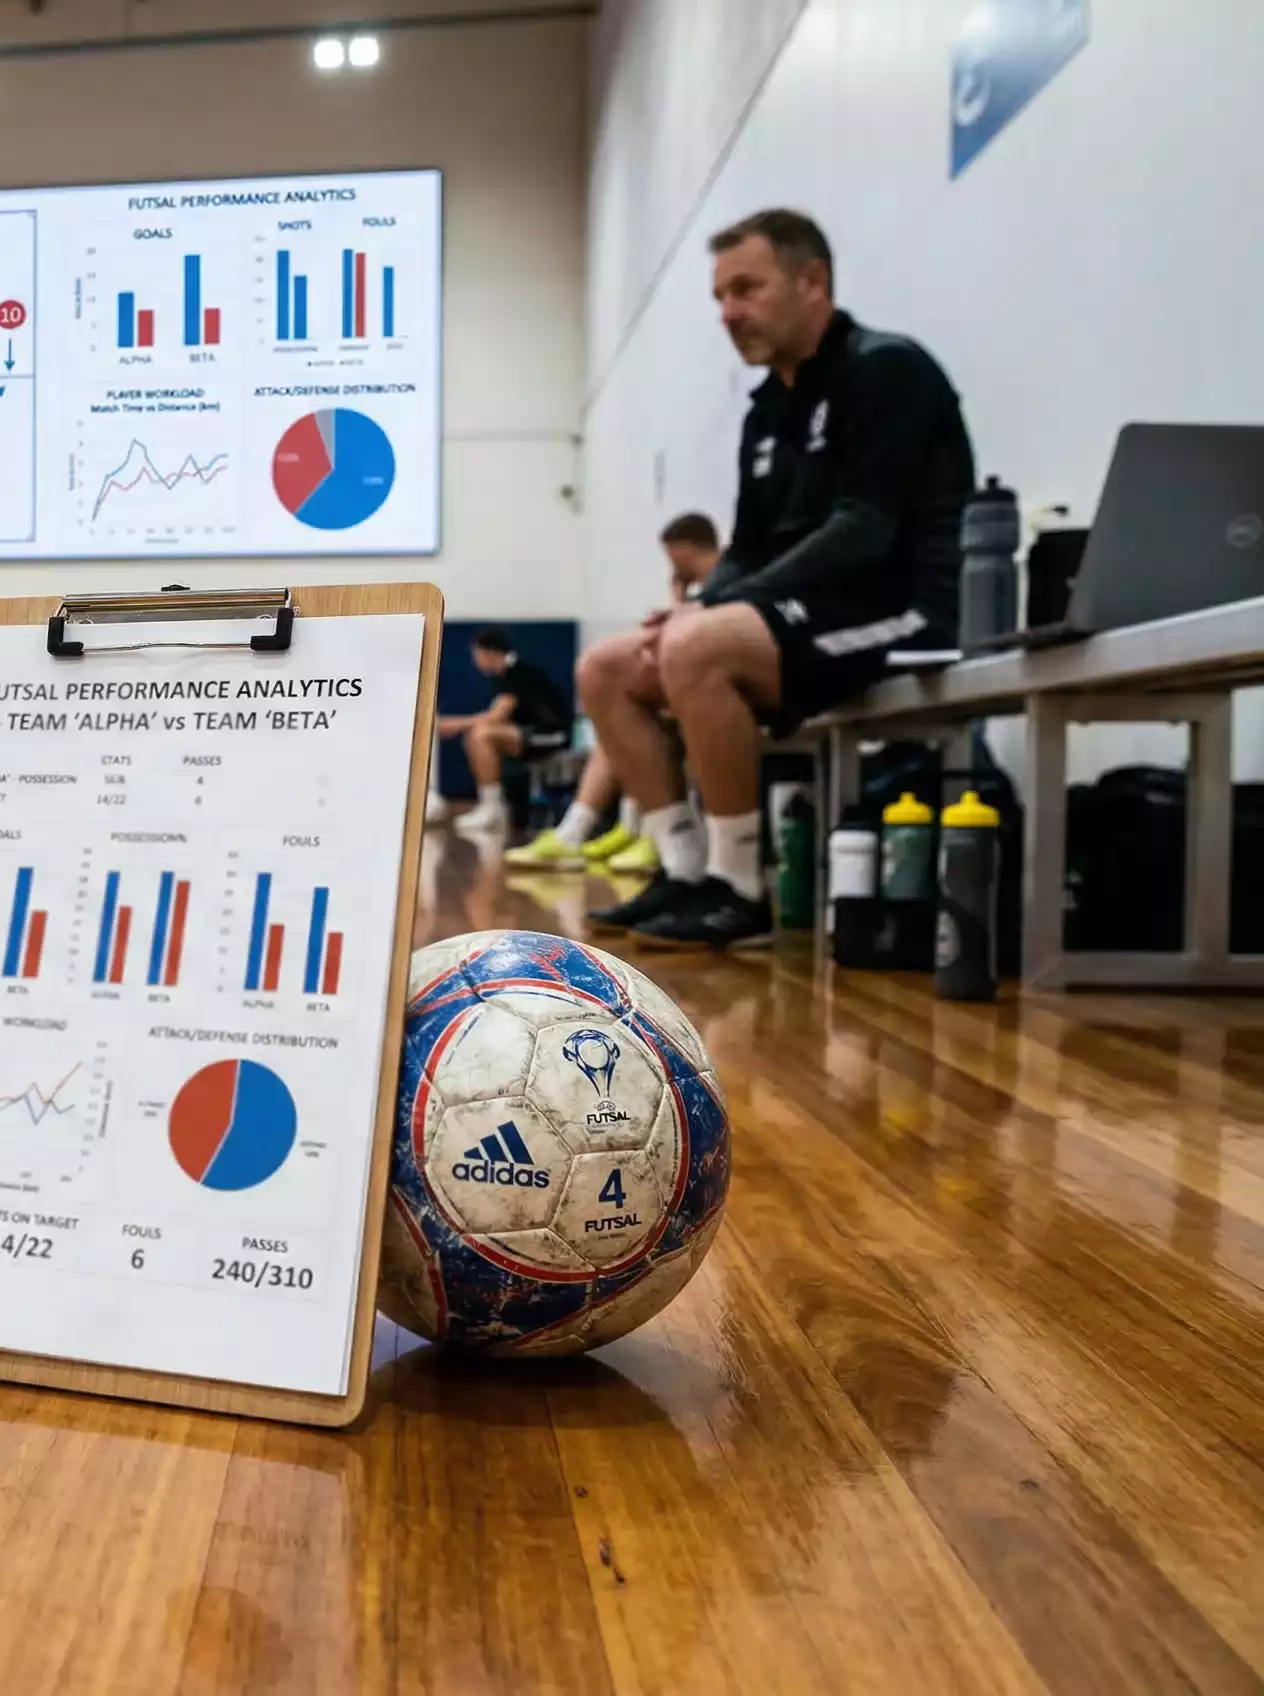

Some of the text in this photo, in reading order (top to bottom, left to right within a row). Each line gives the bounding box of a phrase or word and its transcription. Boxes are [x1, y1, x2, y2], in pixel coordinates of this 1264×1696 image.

[128, 188, 356, 210] FUTSAL PERFORMANCE ANALYTICS
[133, 227, 173, 240] GOALS
[0, 307, 21, 323] 10
[106, 388, 205, 400] PLAYER WORKLOAD
[254, 384, 416, 397] ATTACK/DEFENSE DISTRIBUTION
[65, 681, 230, 700] PERFORMANCE
[236, 678, 363, 698] ANALYTICS
[7, 713, 67, 730] TEAM
[74, 711, 157, 730] ‘ALPHA’
[163, 716, 186, 730] vs
[194, 711, 257, 730] TEAM
[265, 710, 337, 730] ‘BETA’
[183, 755, 222, 767] PASSES
[18, 774, 77, 784] POSSESSION
[282, 835, 320, 847] FOULS
[3, 1016, 68, 1031] WORKLOAD
[148, 1026, 339, 1049] ATTACK/DEFENSE DISTRIBUTION
[587, 1111, 631, 1125] FUTSAL
[452, 1159, 550, 1189] adidas
[598, 1168, 627, 1209] 4
[11, 1211, 30, 1224] ON
[34, 1214, 79, 1230] TARGET
[585, 1213, 642, 1233] FUTSAL
[122, 1223, 162, 1240] FOULS
[242, 1236, 288, 1254] PASSES
[131, 1248, 145, 1269] 6
[211, 1258, 313, 1289] 240/310
